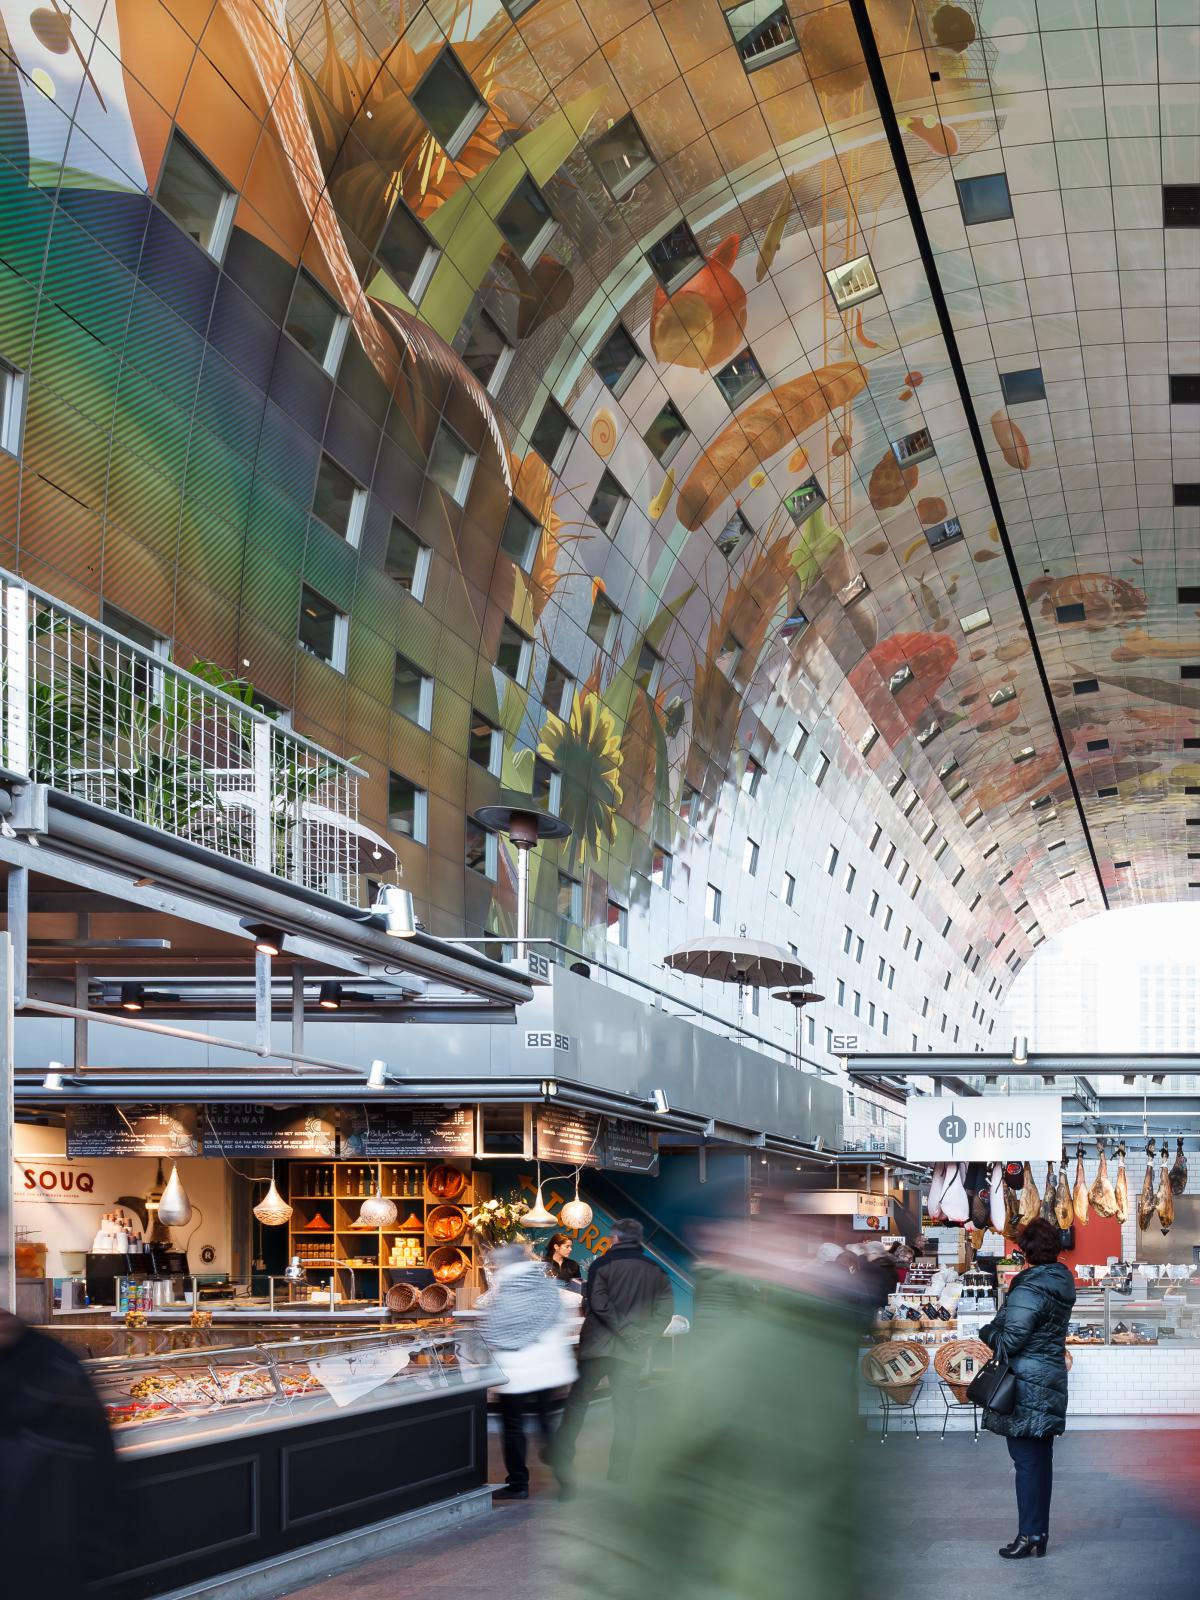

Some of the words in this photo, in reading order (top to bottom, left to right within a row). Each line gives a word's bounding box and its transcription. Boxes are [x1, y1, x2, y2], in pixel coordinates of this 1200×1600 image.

[528, 1033, 551, 1047] 86
[555, 1033, 569, 1051] 86
[833, 1035, 858, 1049] 52
[946, 1121, 959, 1138] 21
[974, 1122, 1031, 1139] PINCHOS
[24, 1169, 94, 1193] SOUQ
